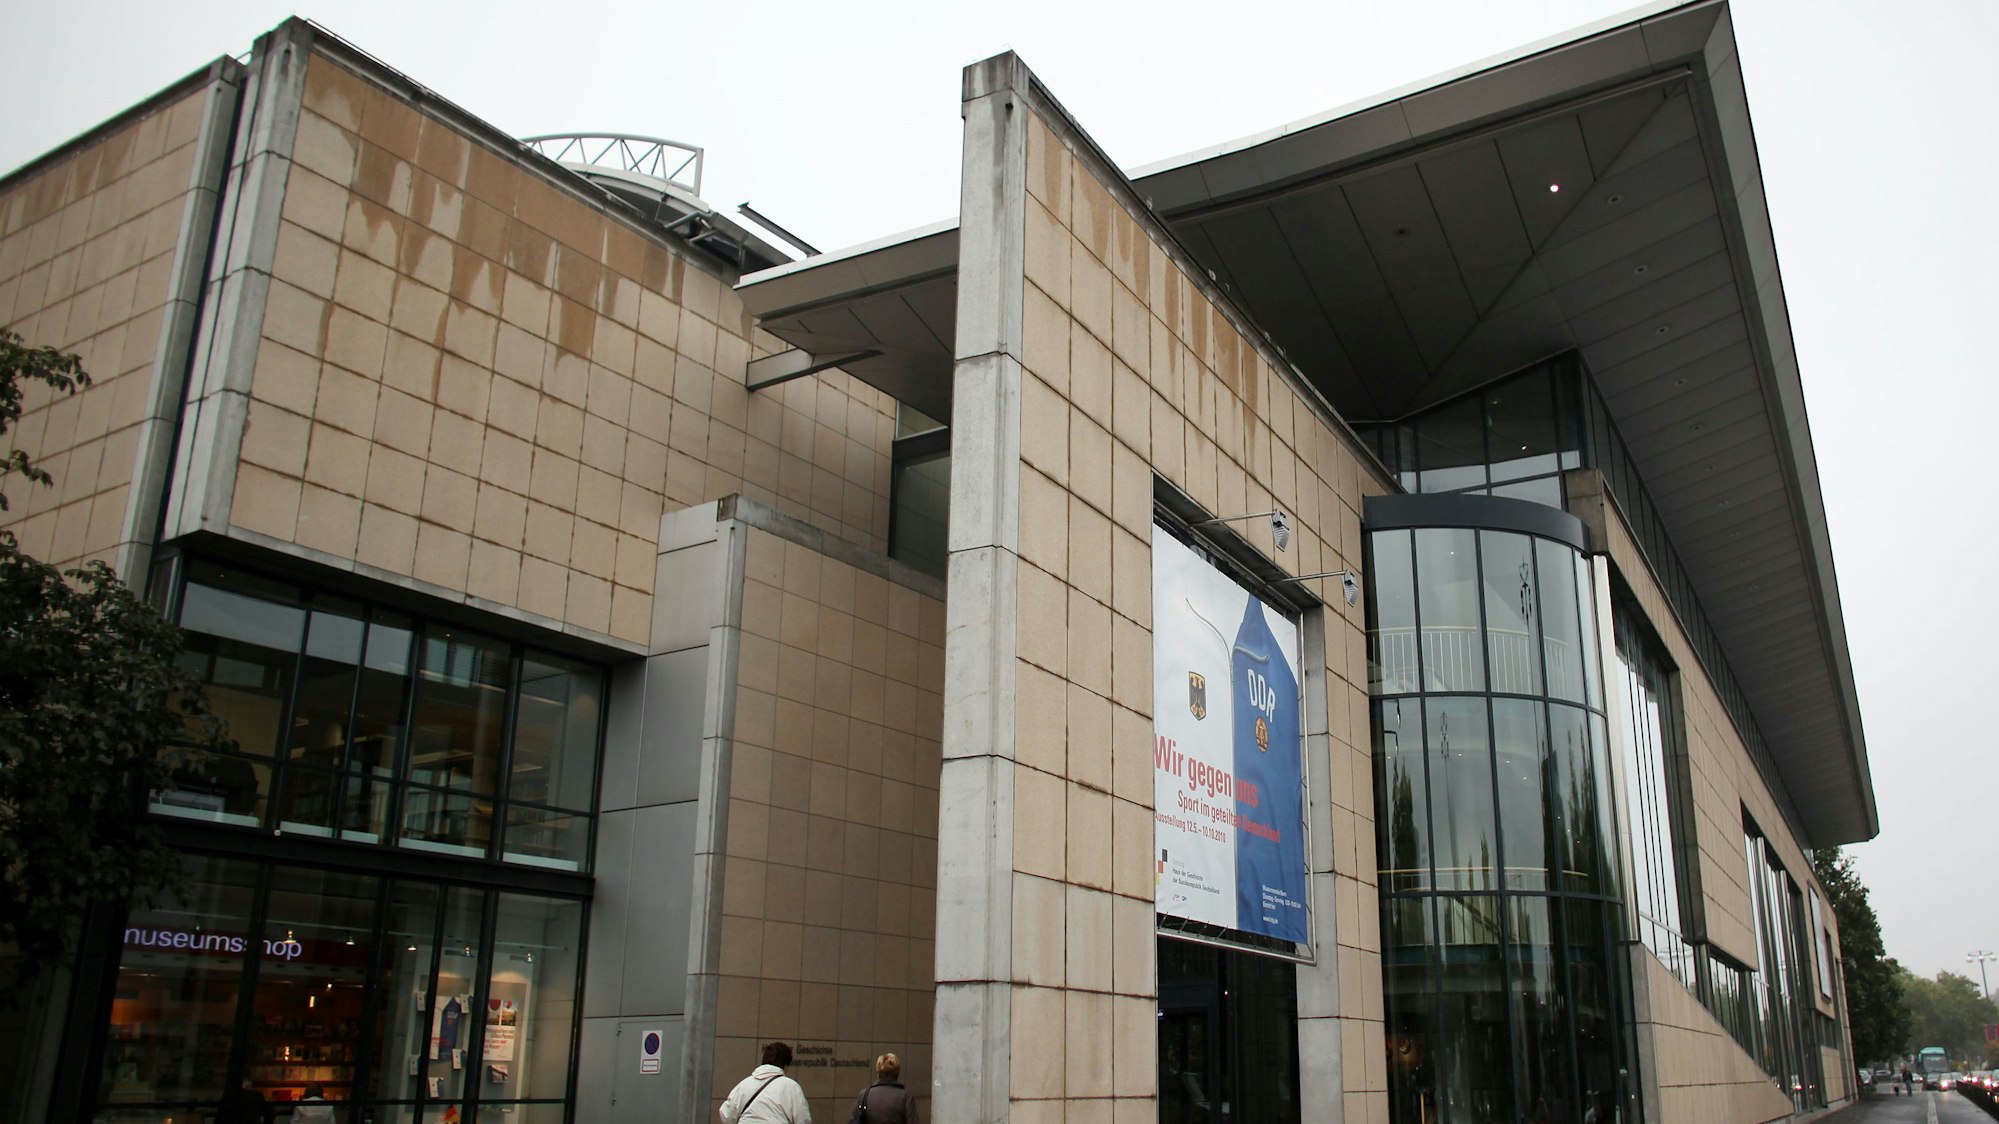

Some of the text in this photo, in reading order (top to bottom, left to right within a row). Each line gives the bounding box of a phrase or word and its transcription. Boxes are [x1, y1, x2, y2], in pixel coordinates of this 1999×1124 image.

[1247, 668, 1276, 723] DDR
[1154, 733, 1260, 809] Wir gegen uns
[1177, 789, 1199, 814] Sport
[1200, 797, 1210, 818] im
[1211, 806, 1241, 829] geteilten
